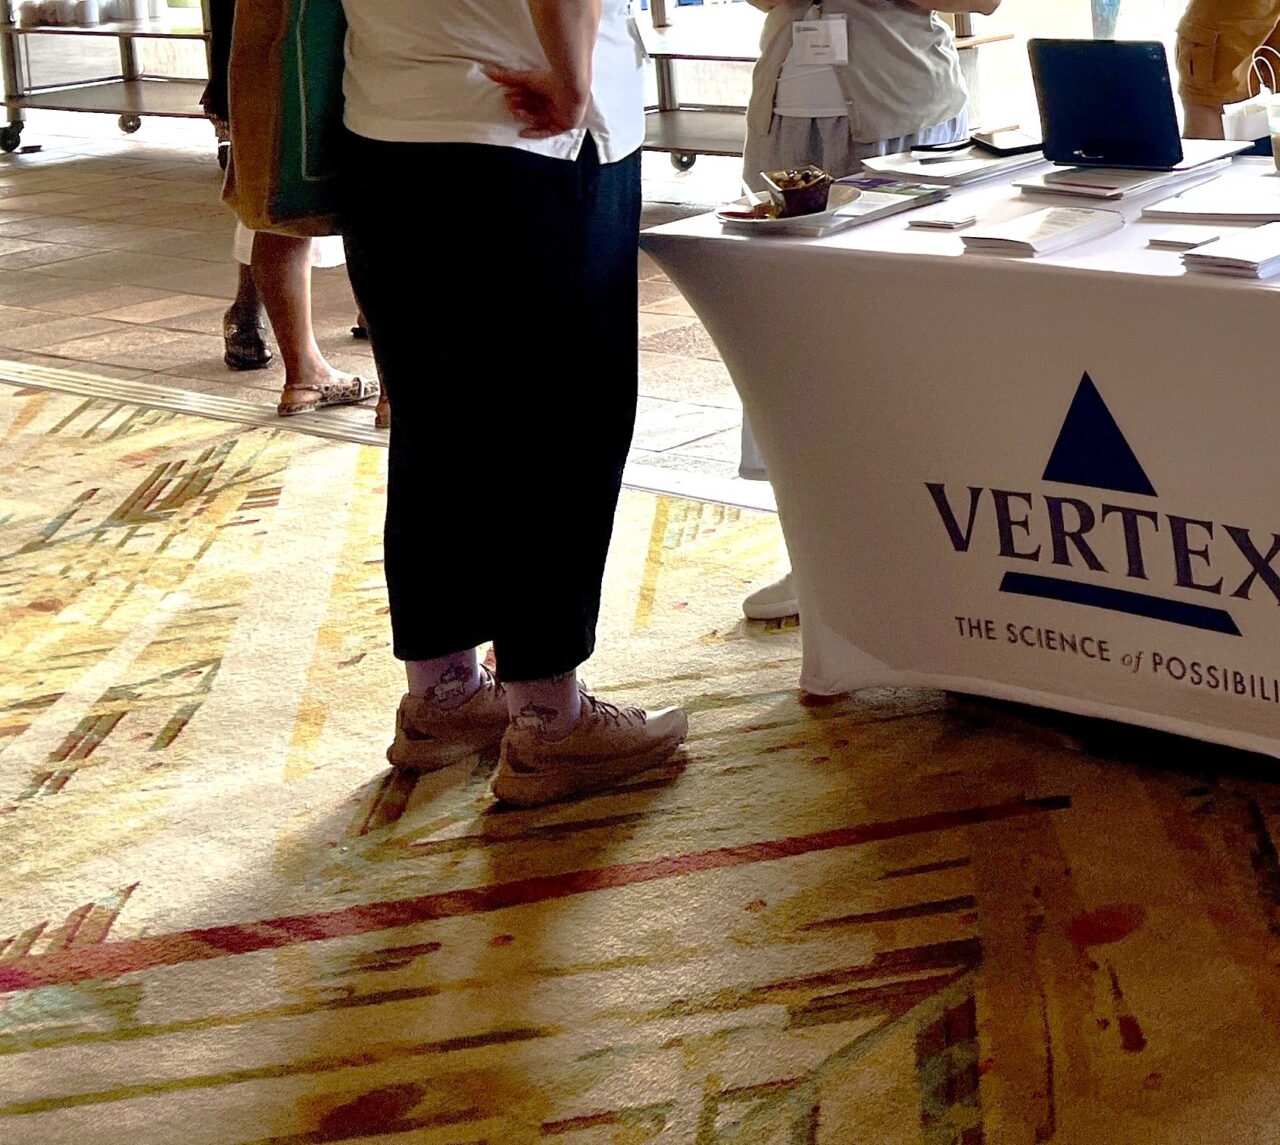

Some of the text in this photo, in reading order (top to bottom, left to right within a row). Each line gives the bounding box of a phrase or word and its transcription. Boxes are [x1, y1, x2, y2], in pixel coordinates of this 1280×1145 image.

[955, 616, 997, 640] THE
[1006, 622, 1111, 661] SCIENCE
[1119, 651, 1145, 673] of
